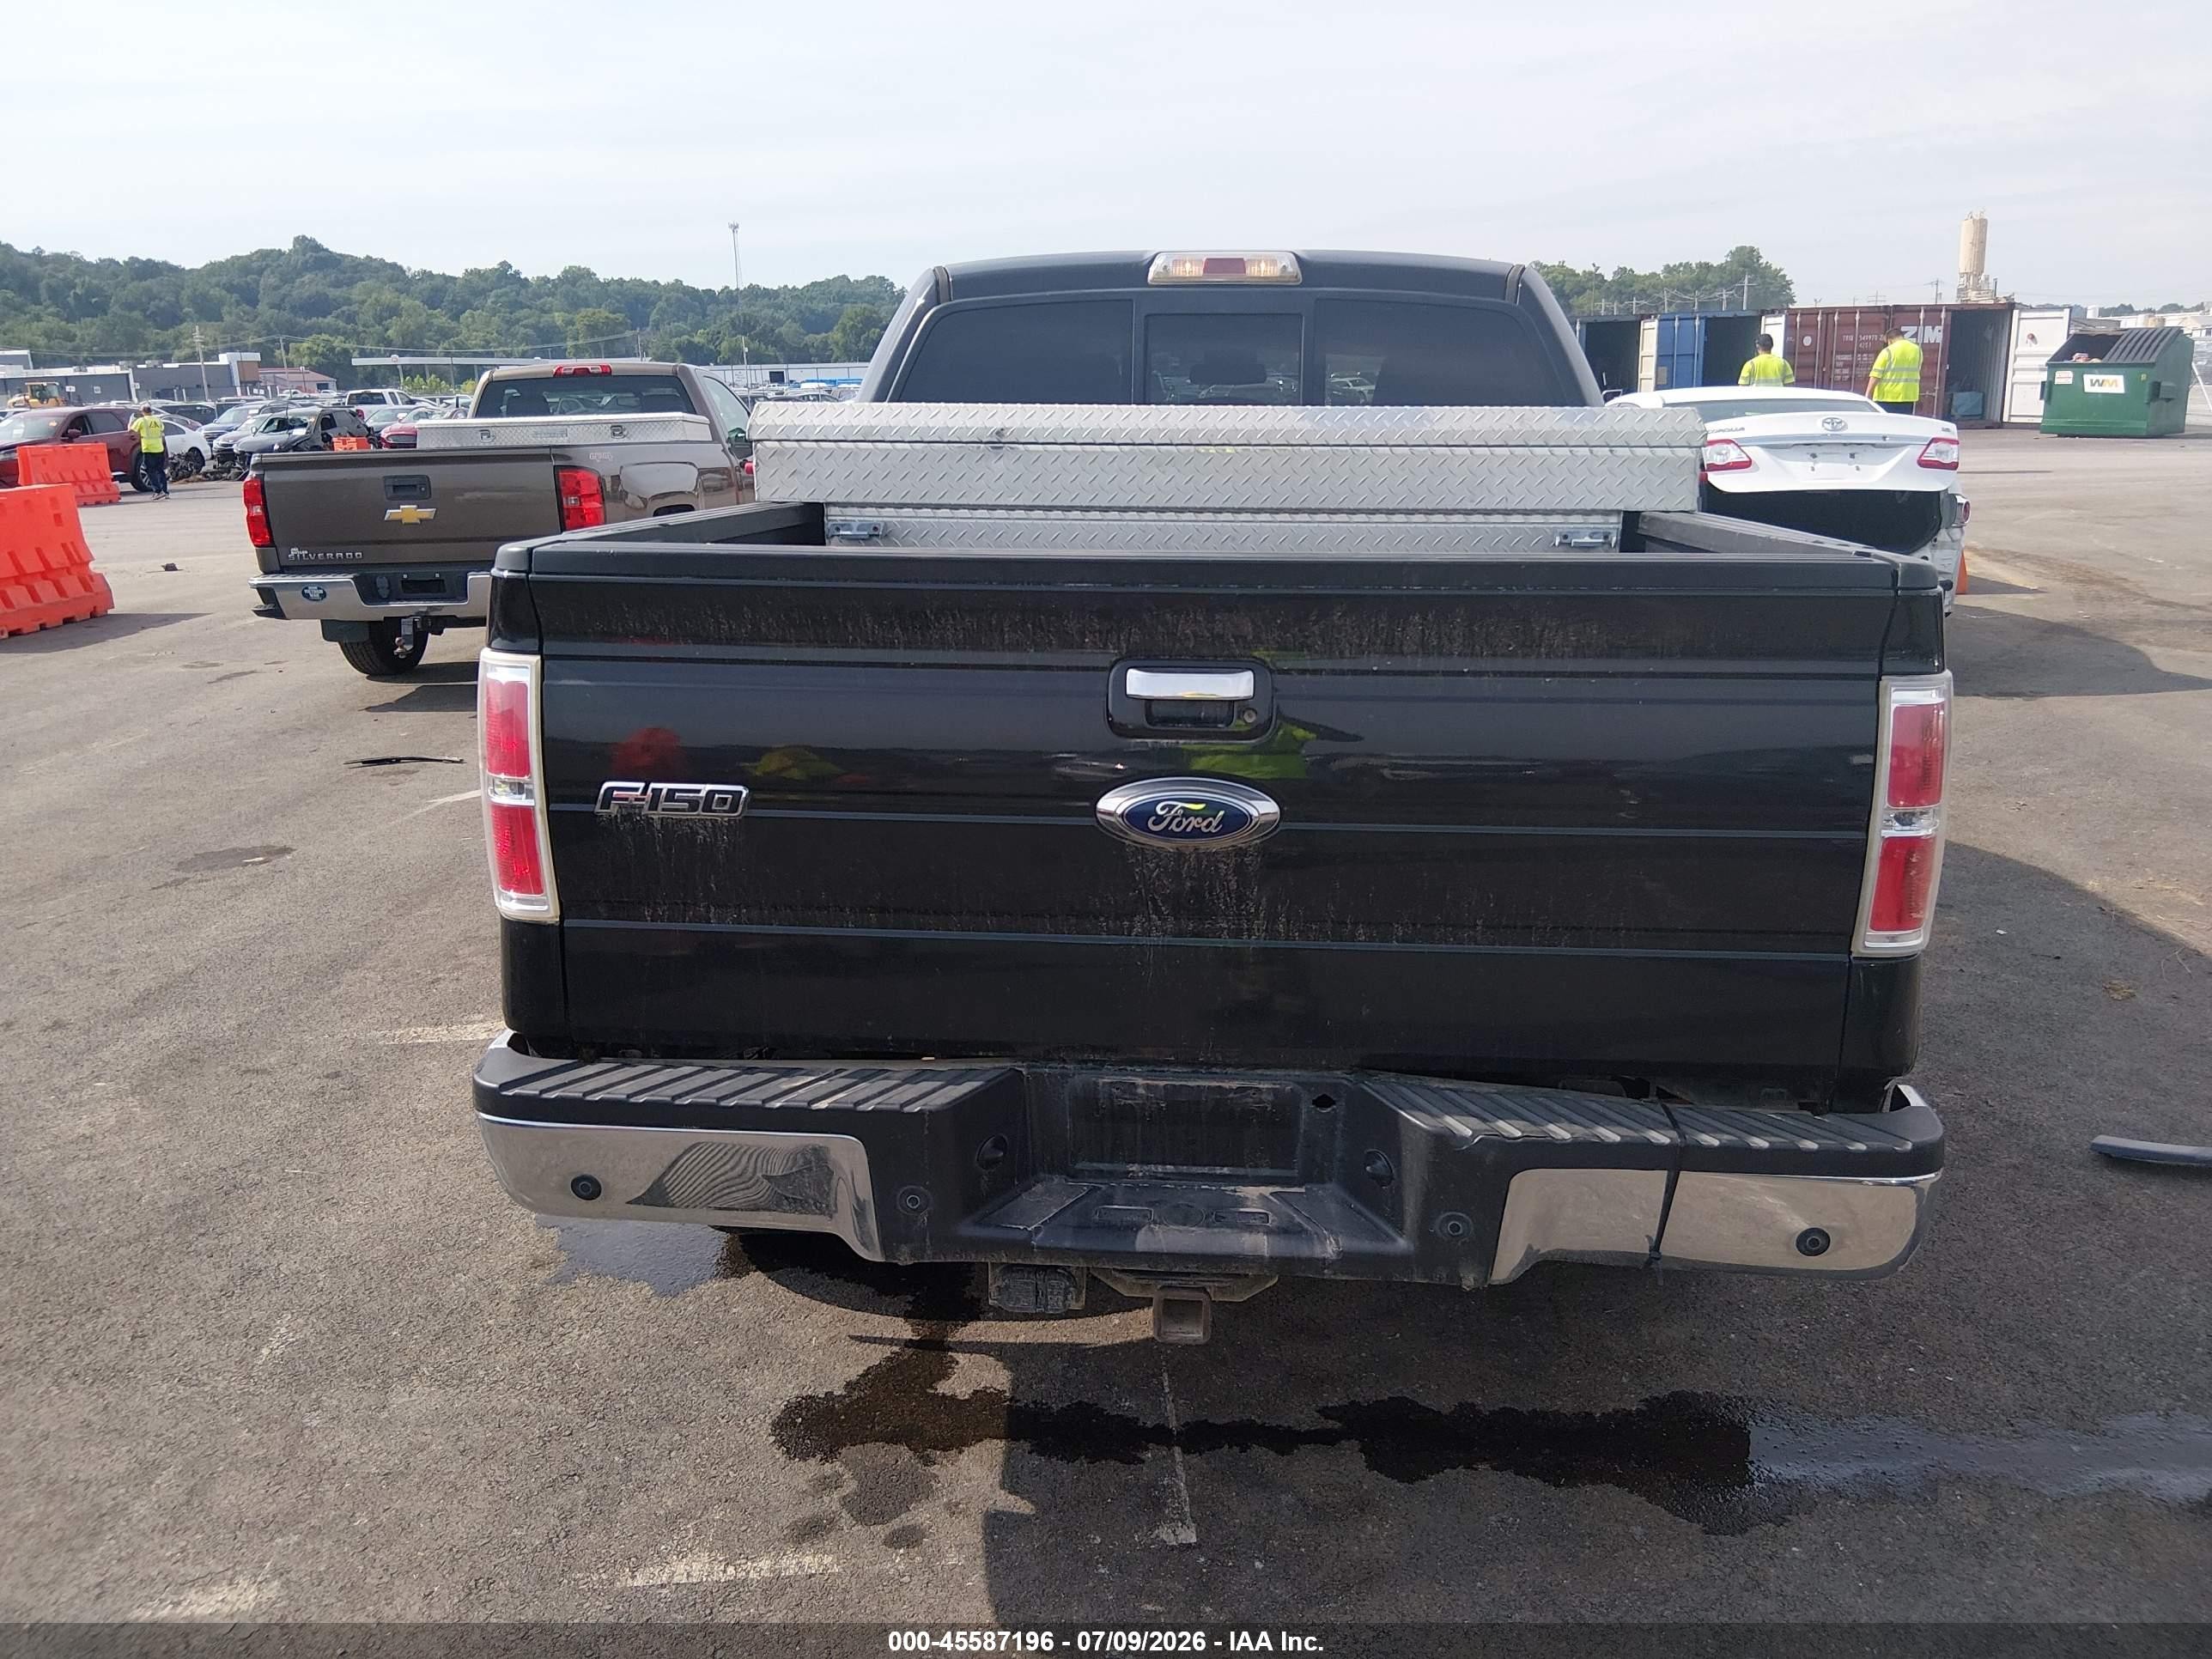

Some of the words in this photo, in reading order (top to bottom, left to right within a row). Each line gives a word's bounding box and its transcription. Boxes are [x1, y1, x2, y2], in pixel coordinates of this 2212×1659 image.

[1900, 325, 1942, 343] ZIM
[2089, 379, 2119, 387] WM
[288, 551, 362, 561] SILVERADO
[1147, 800, 1225, 833] Ford
